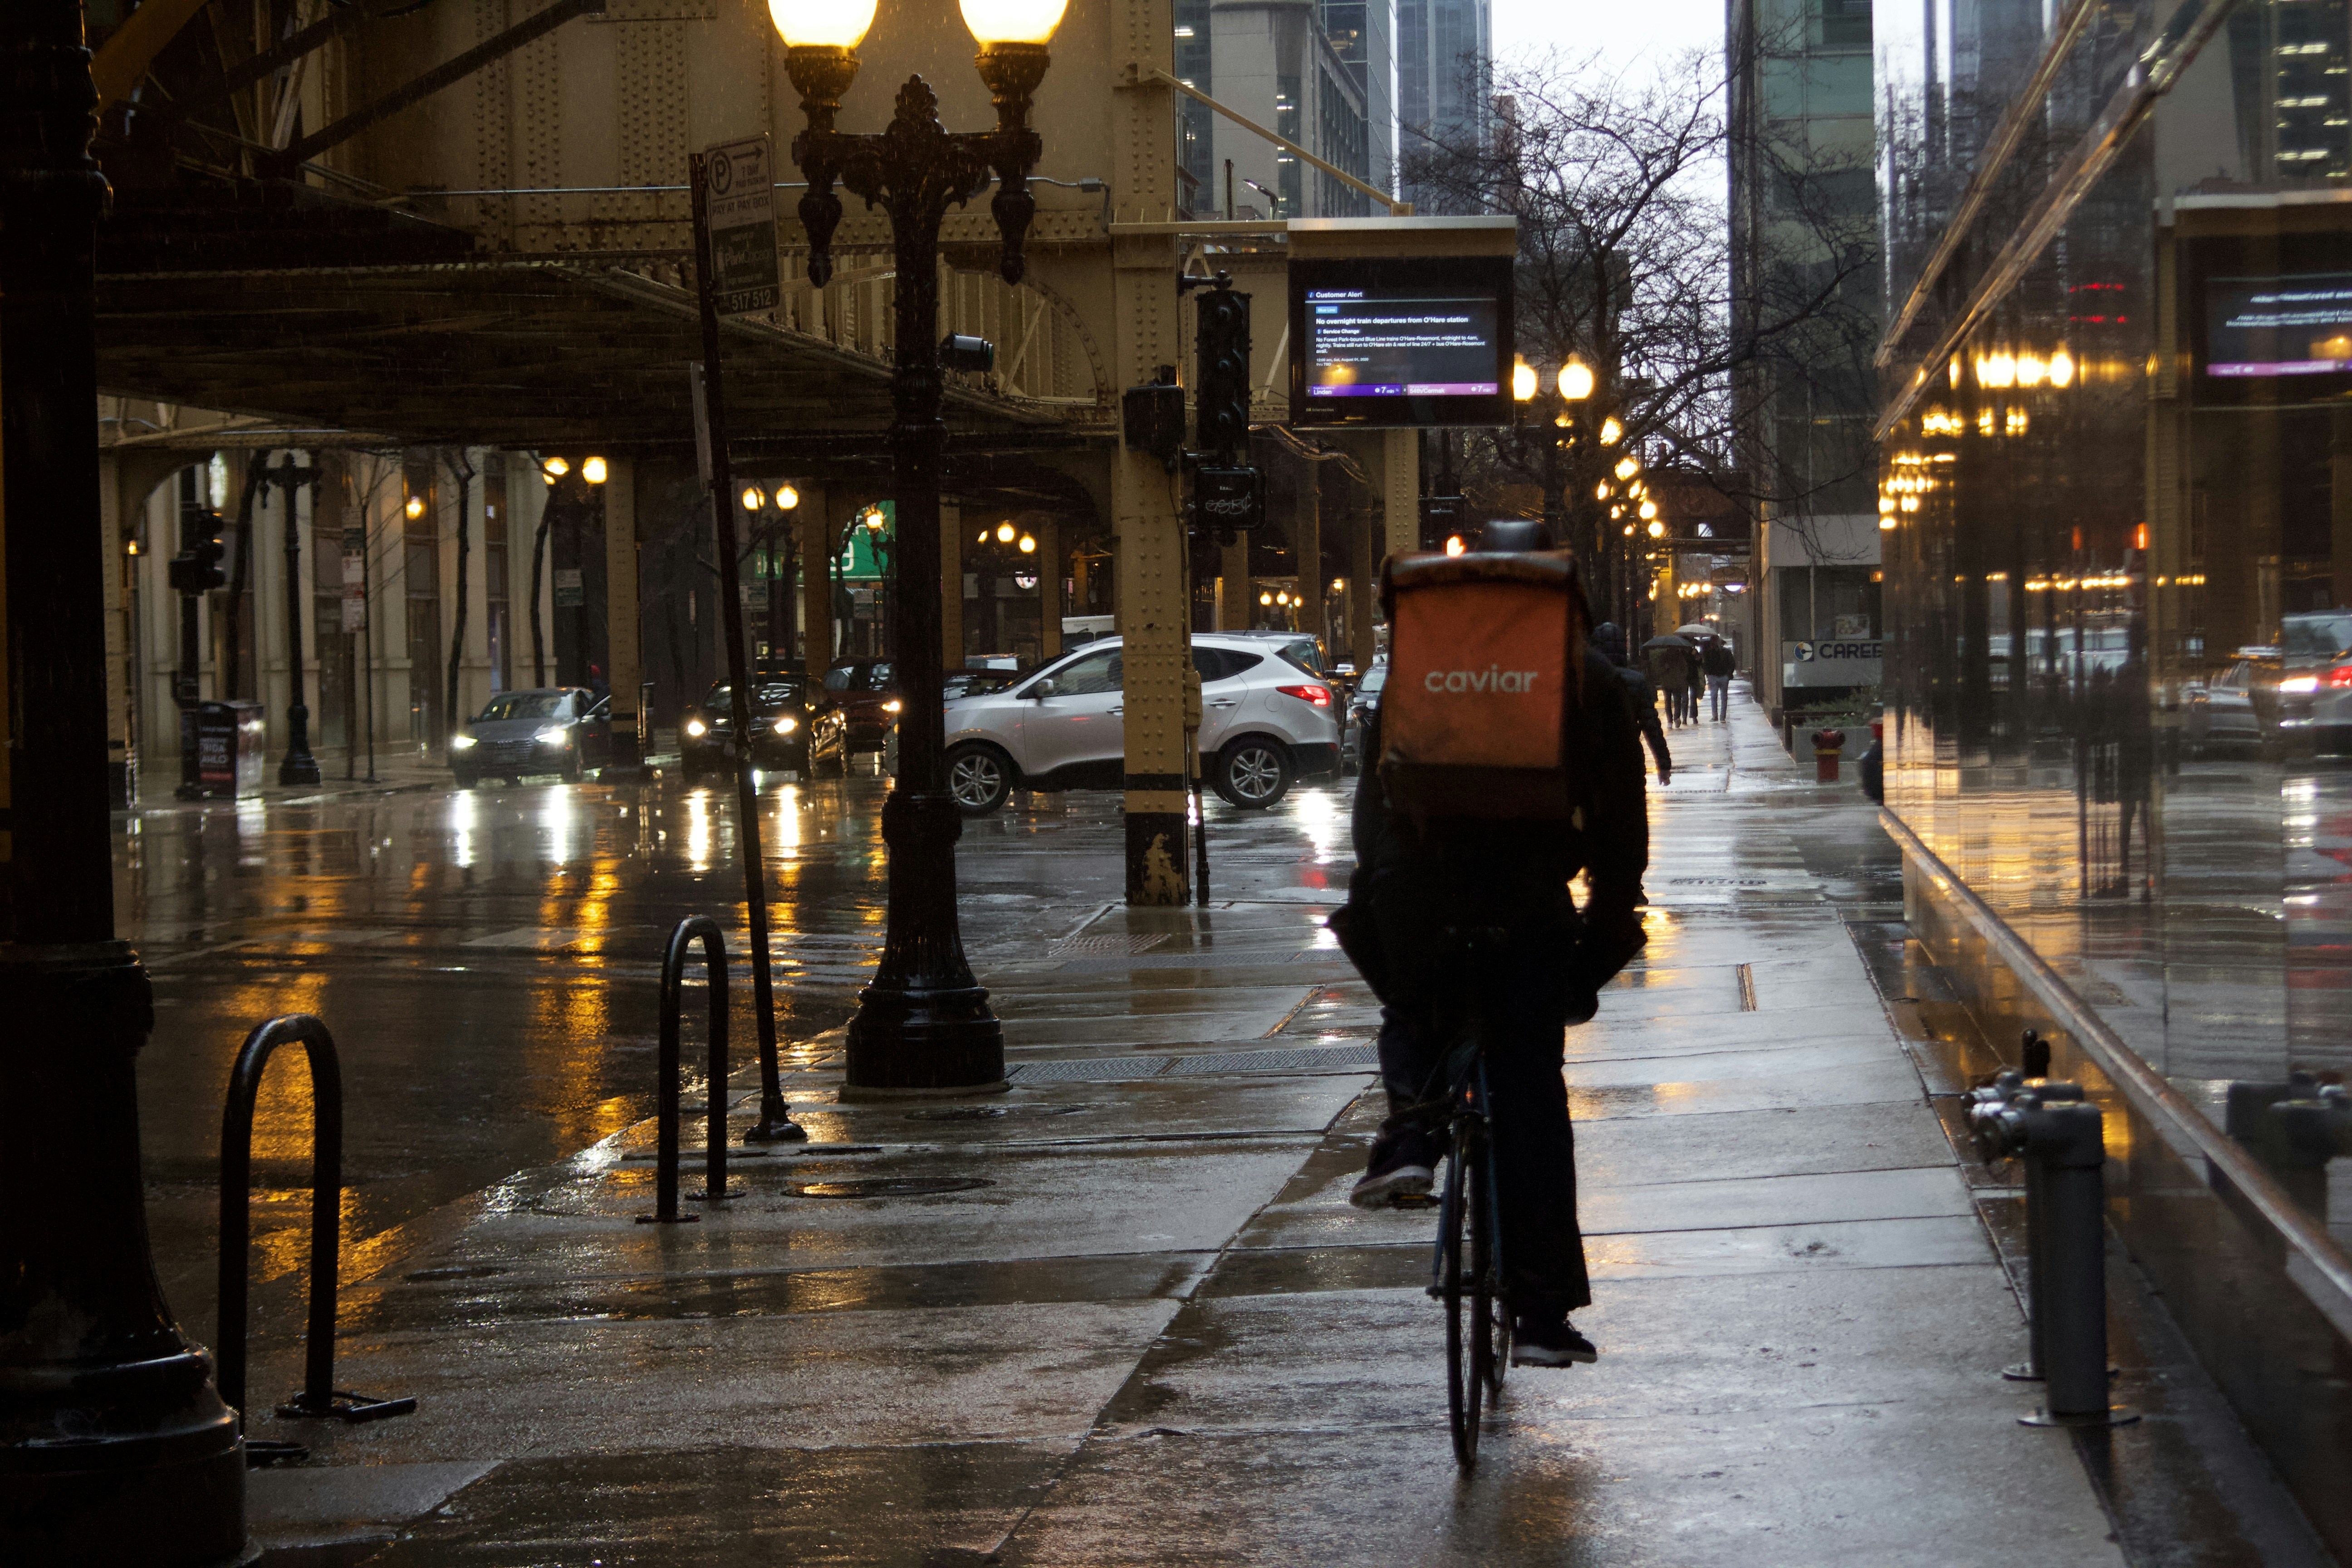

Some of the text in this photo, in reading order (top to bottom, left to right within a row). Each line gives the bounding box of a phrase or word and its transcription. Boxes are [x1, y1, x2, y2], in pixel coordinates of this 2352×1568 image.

[711, 196, 769, 216] PAY AT PAY BOX
[732, 289, 771, 311] 517 512
[1819, 642, 1882, 659] CAREE
[1424, 663, 1539, 692] caviar
